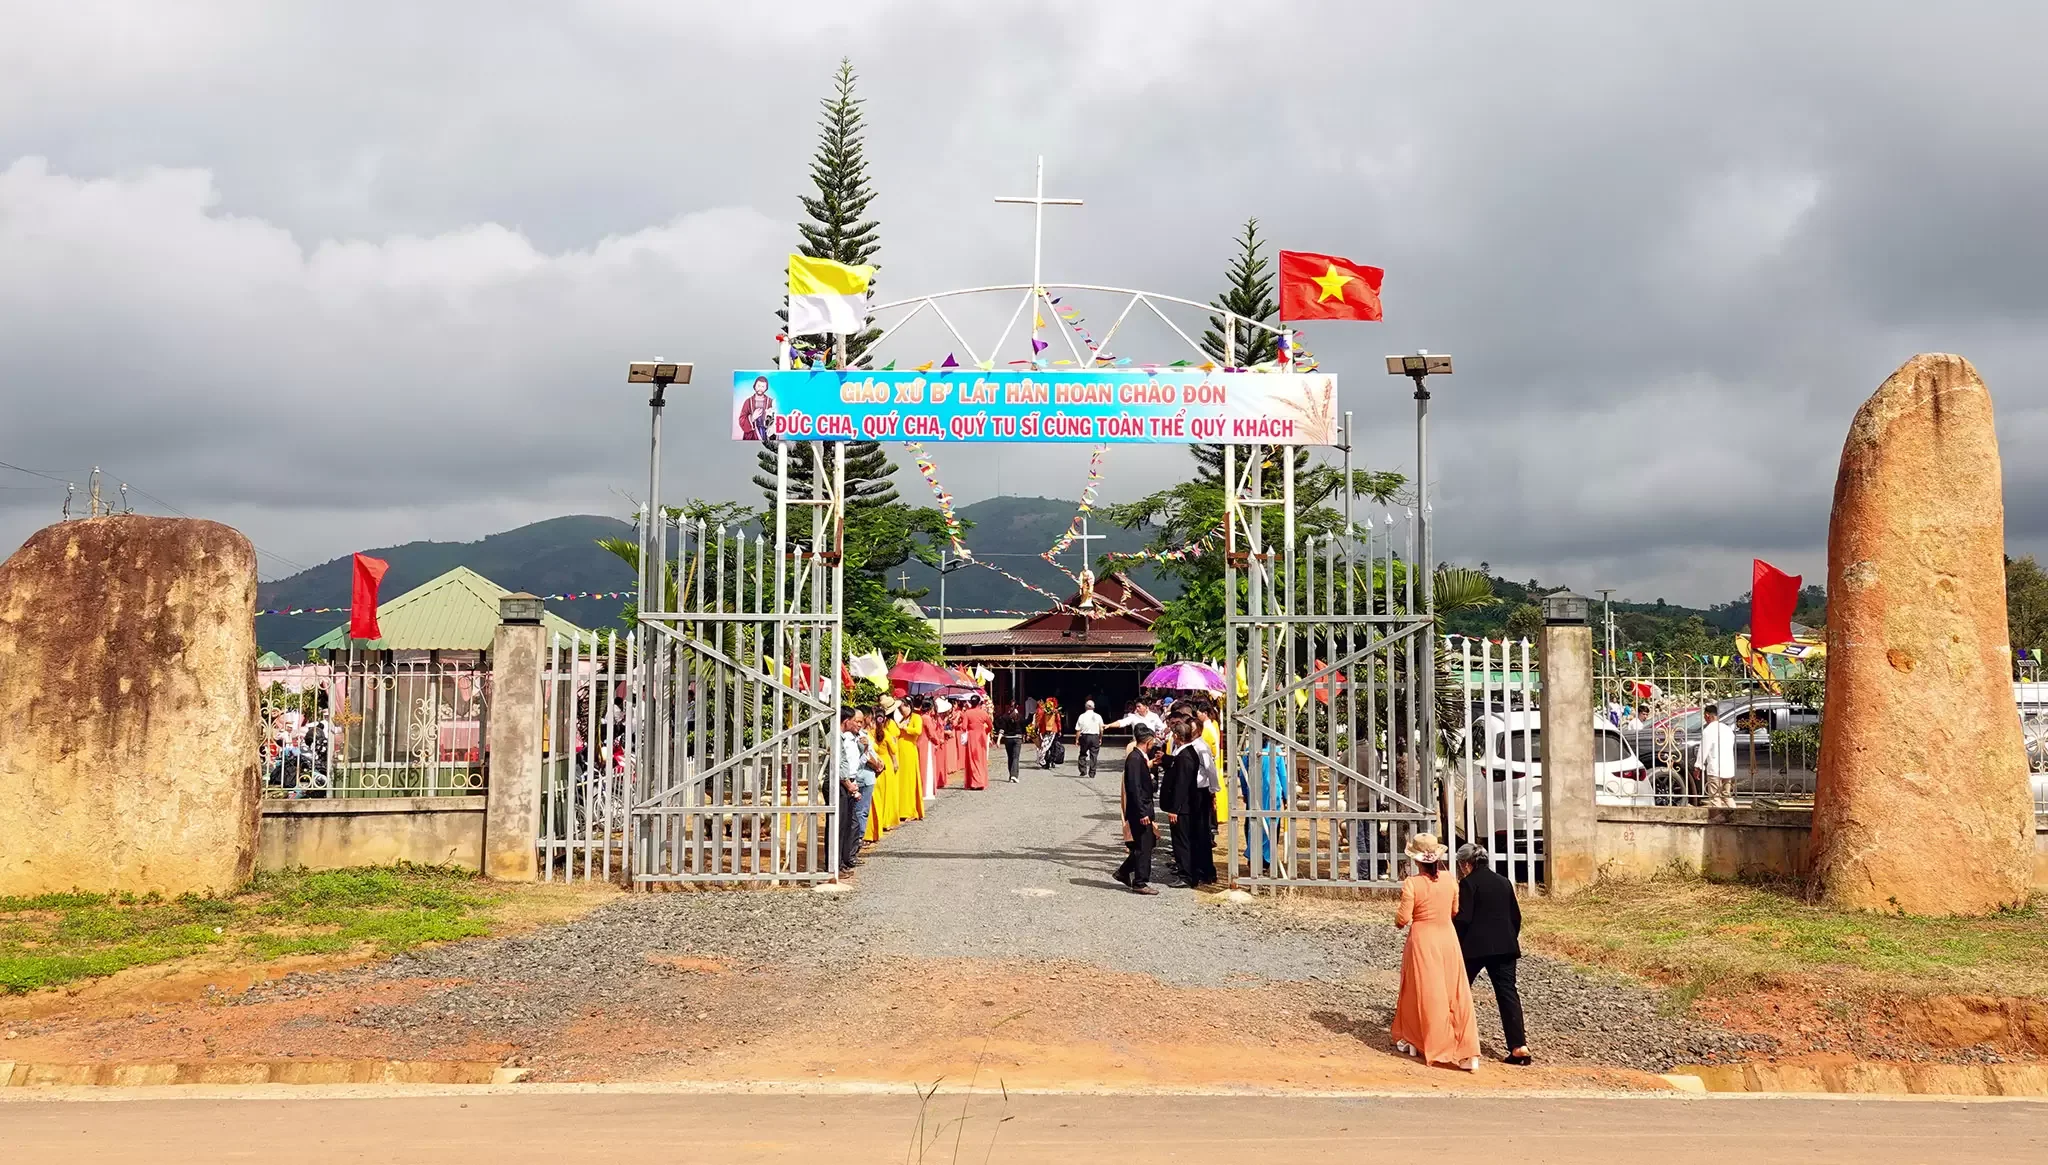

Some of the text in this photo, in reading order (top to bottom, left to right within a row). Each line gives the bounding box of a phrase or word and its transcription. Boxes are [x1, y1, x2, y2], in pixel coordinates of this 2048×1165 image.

[841, 378, 890, 403] GIÁO
[894, 378, 926, 403] XỨ
[959, 378, 999, 403] LÁT
[1006, 379, 1049, 403] HÂN
[1055, 383, 1113, 403] HOAN
[1119, 381, 1176, 404] CHÀO
[1182, 381, 1227, 404] ĐÓN
[775, 408, 1293, 439] ĐỨC CHA, QUÝ CHA, QUÝ TU SĨ CÙNG TOÀN THỂ QUÝ KHÁCH
[1623, 831, 1635, 841] 82
